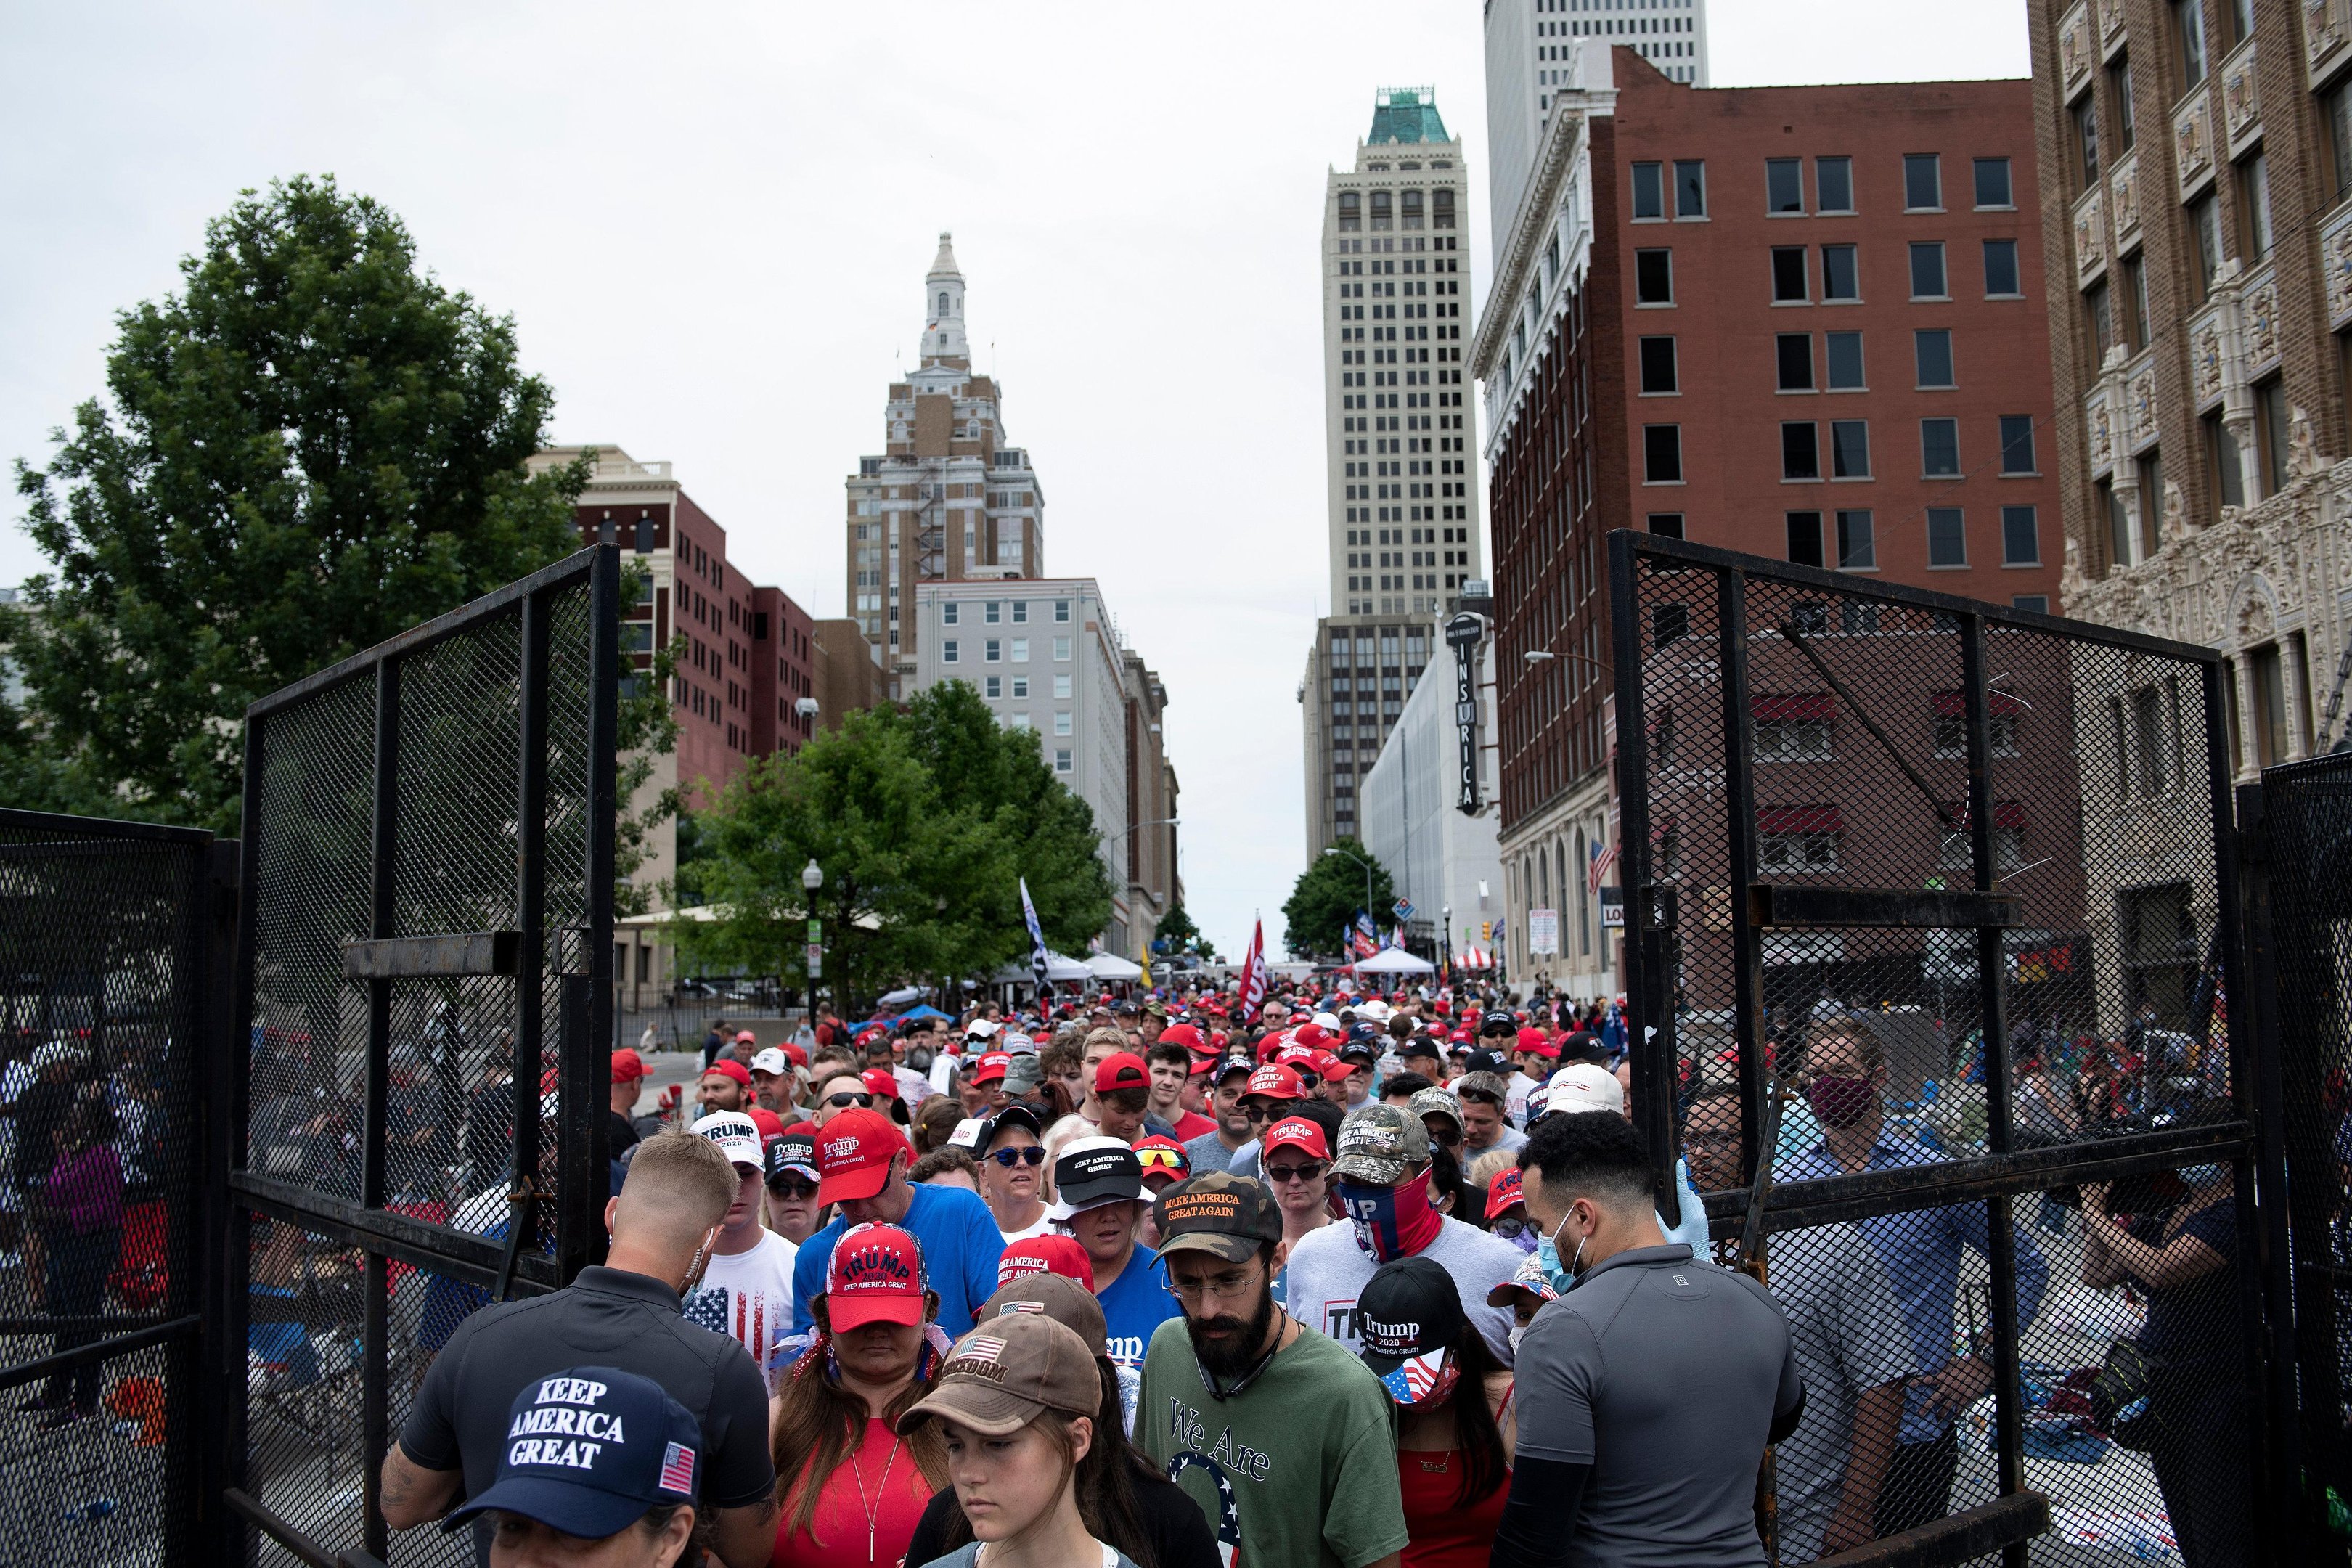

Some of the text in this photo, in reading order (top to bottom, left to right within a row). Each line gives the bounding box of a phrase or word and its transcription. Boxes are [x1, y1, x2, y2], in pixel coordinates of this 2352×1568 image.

[1458, 642, 1473, 805] INSURICA
[1606, 909, 1625, 921] LO
[1257, 1066, 1277, 1075] KEEP
[1250, 1073, 1284, 1085] AMERICA
[1252, 1081, 1278, 1091] GREAT
[1527, 1089, 1548, 1106] TRU
[1351, 1120, 1376, 1129] 2020
[1273, 1125, 1313, 1139] TRUMP
[774, 1143, 813, 1156] Trump
[823, 1139, 859, 1155] Trump
[835, 1148, 853, 1157] 2020
[1074, 1155, 1125, 1169] KEEP AMERICA
[1087, 1163, 1113, 1173] GREAT
[1164, 1193, 1240, 1209] MAKE AMERICA
[1168, 1206, 1234, 1220] GREAT AGAIN
[842, 1252, 910, 1281] TRUMP
[1009, 1257, 1048, 1269] AMERICA
[862, 1272, 887, 1281] 2020
[844, 1283, 857, 1291] KEEP
[888, 1281, 907, 1290] GREAT
[1328, 1307, 1365, 1339] TR
[1364, 1312, 1420, 1342] Trump
[1379, 1338, 1400, 1347] 2020
[534, 1377, 607, 1405] KEEP
[508, 1407, 625, 1443] AMERICA
[1170, 1396, 1270, 1482] We Are
[509, 1438, 602, 1469] GREAT
